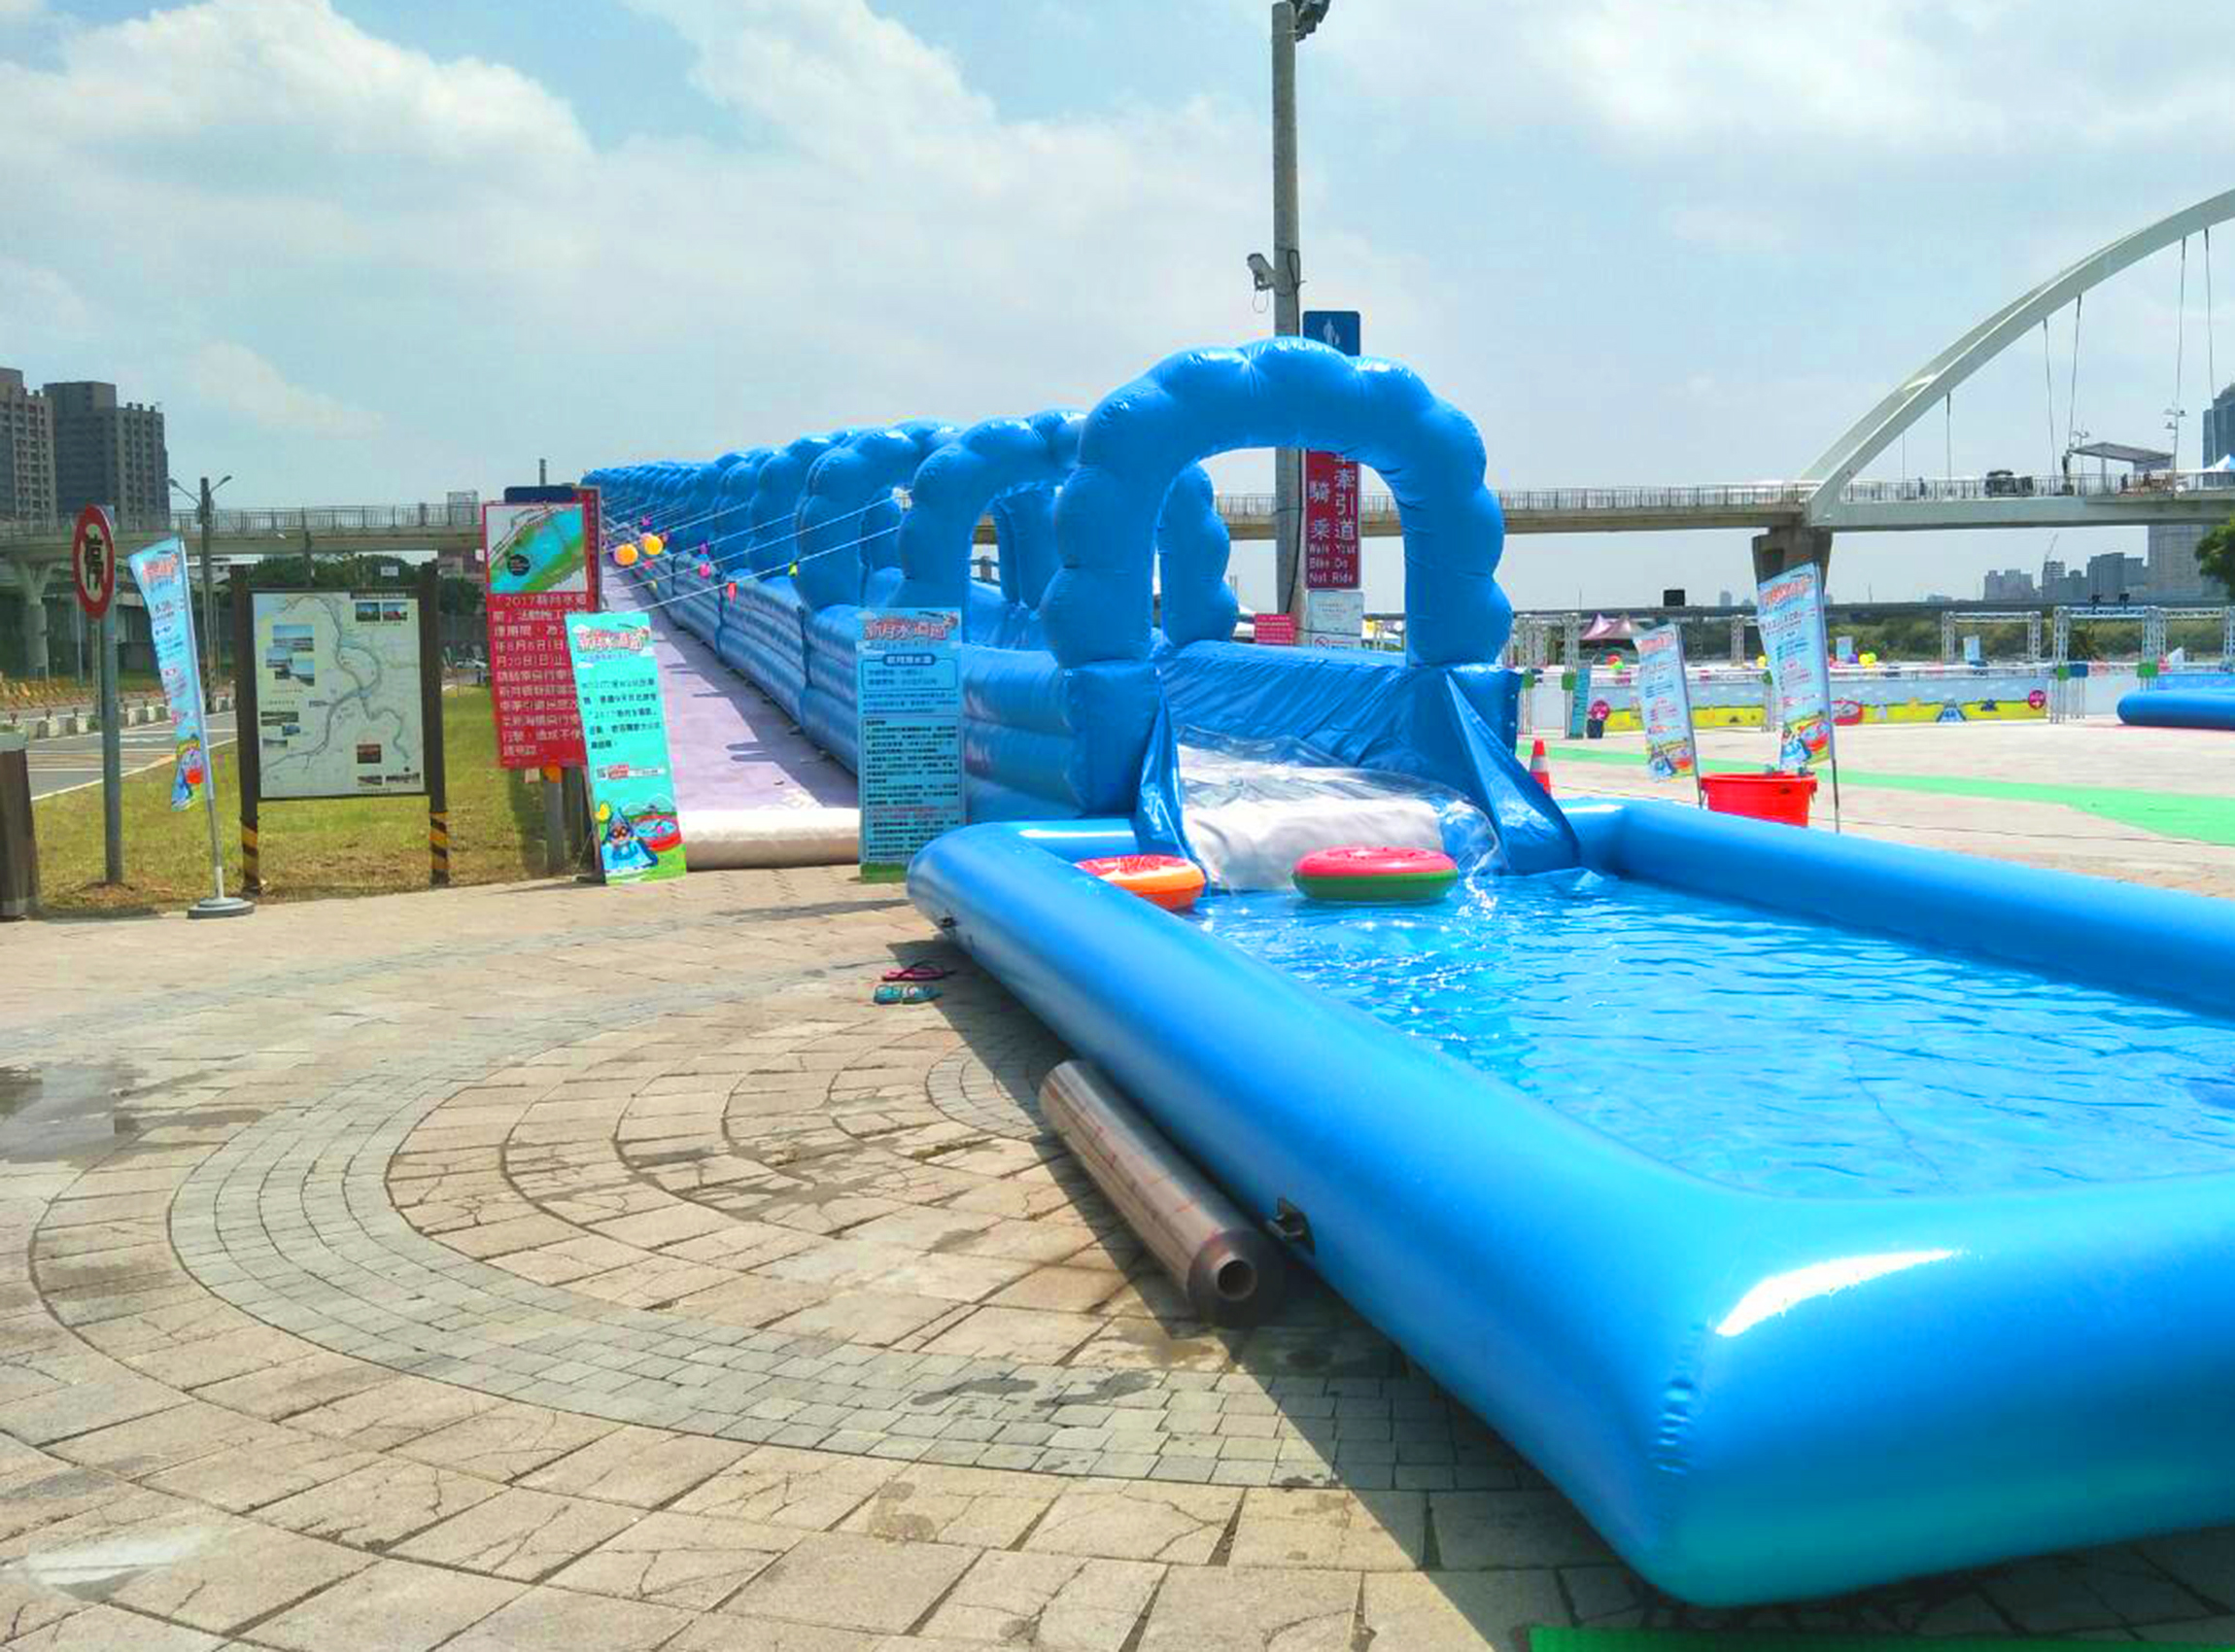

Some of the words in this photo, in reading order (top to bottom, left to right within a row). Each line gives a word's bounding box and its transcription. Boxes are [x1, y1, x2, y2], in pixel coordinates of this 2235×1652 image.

[1333, 458, 1356, 540] 牽引道
[1309, 543, 1329, 555] Walk
[1336, 543, 1357, 555] Your
[1309, 557, 1330, 569] Bike
[1335, 558, 1349, 569] Do
[1309, 572, 1327, 584] Not
[1332, 572, 1354, 584] Ride
